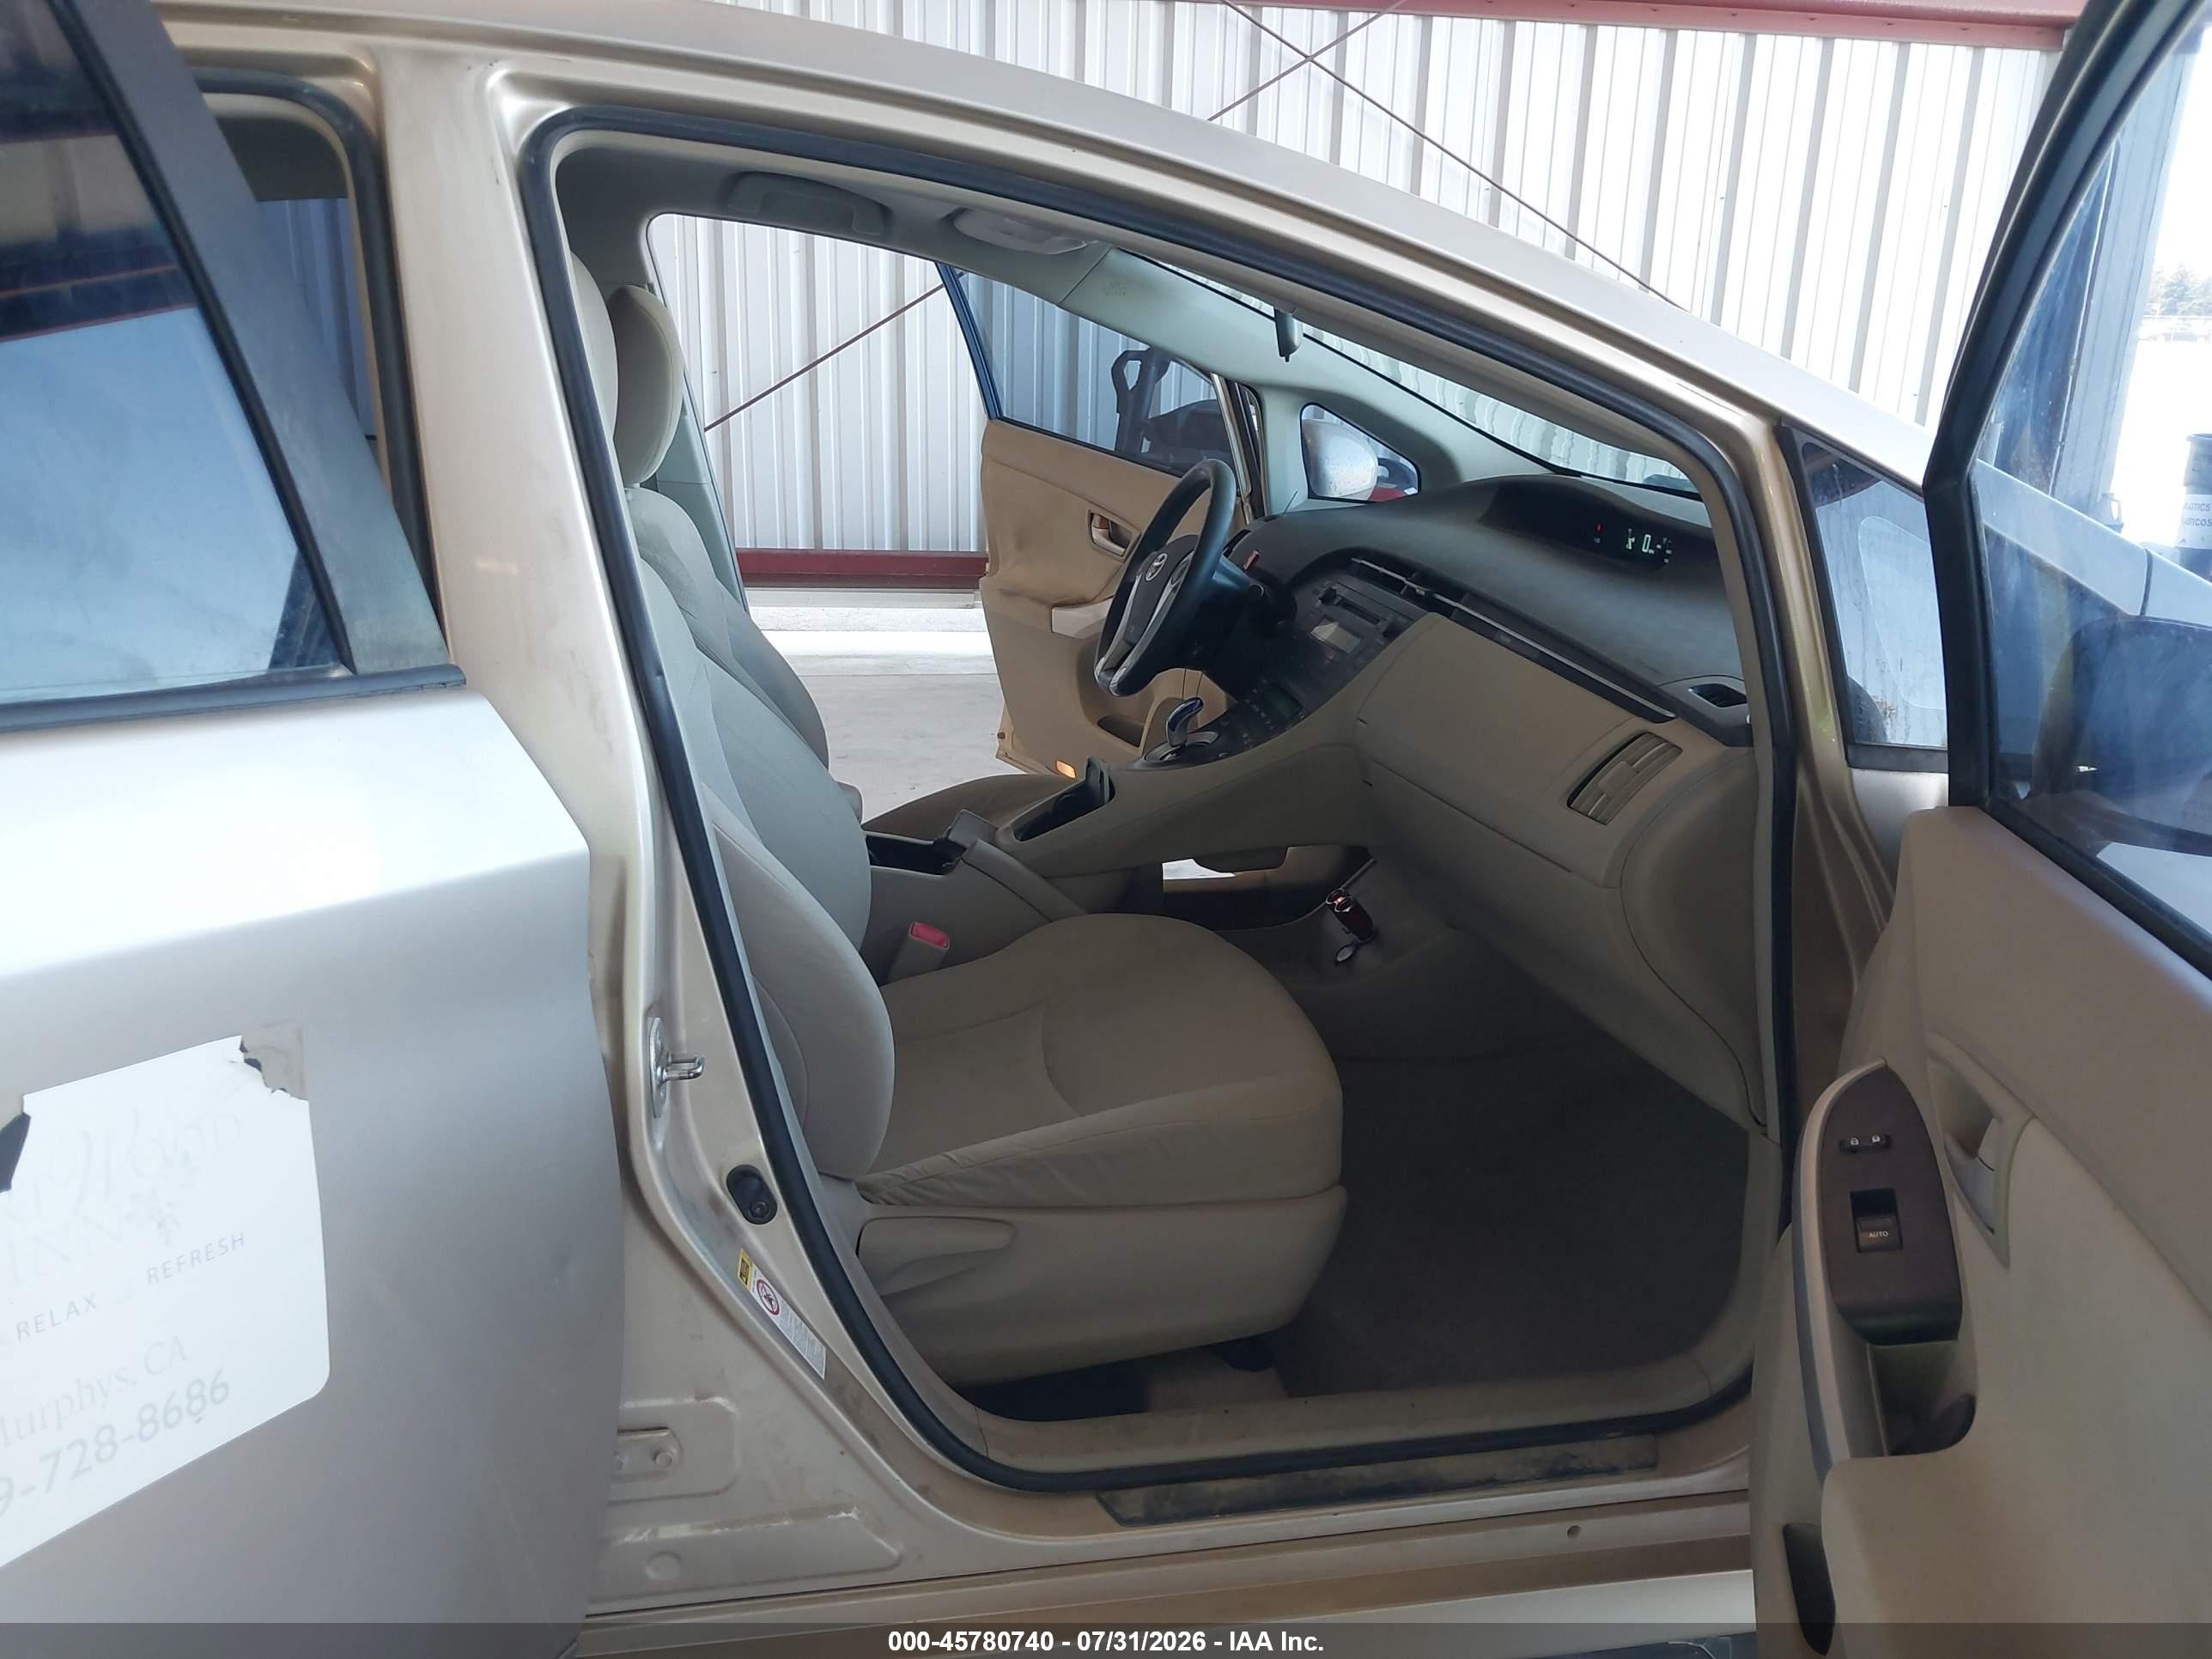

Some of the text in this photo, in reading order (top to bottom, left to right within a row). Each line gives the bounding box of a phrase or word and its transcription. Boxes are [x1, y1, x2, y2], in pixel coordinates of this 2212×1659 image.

[1869, 1230, 1889, 1238] AUTO
[15, 1231, 247, 1341] RELAX REFRESH
[143, 1334, 191, 1376] CA
